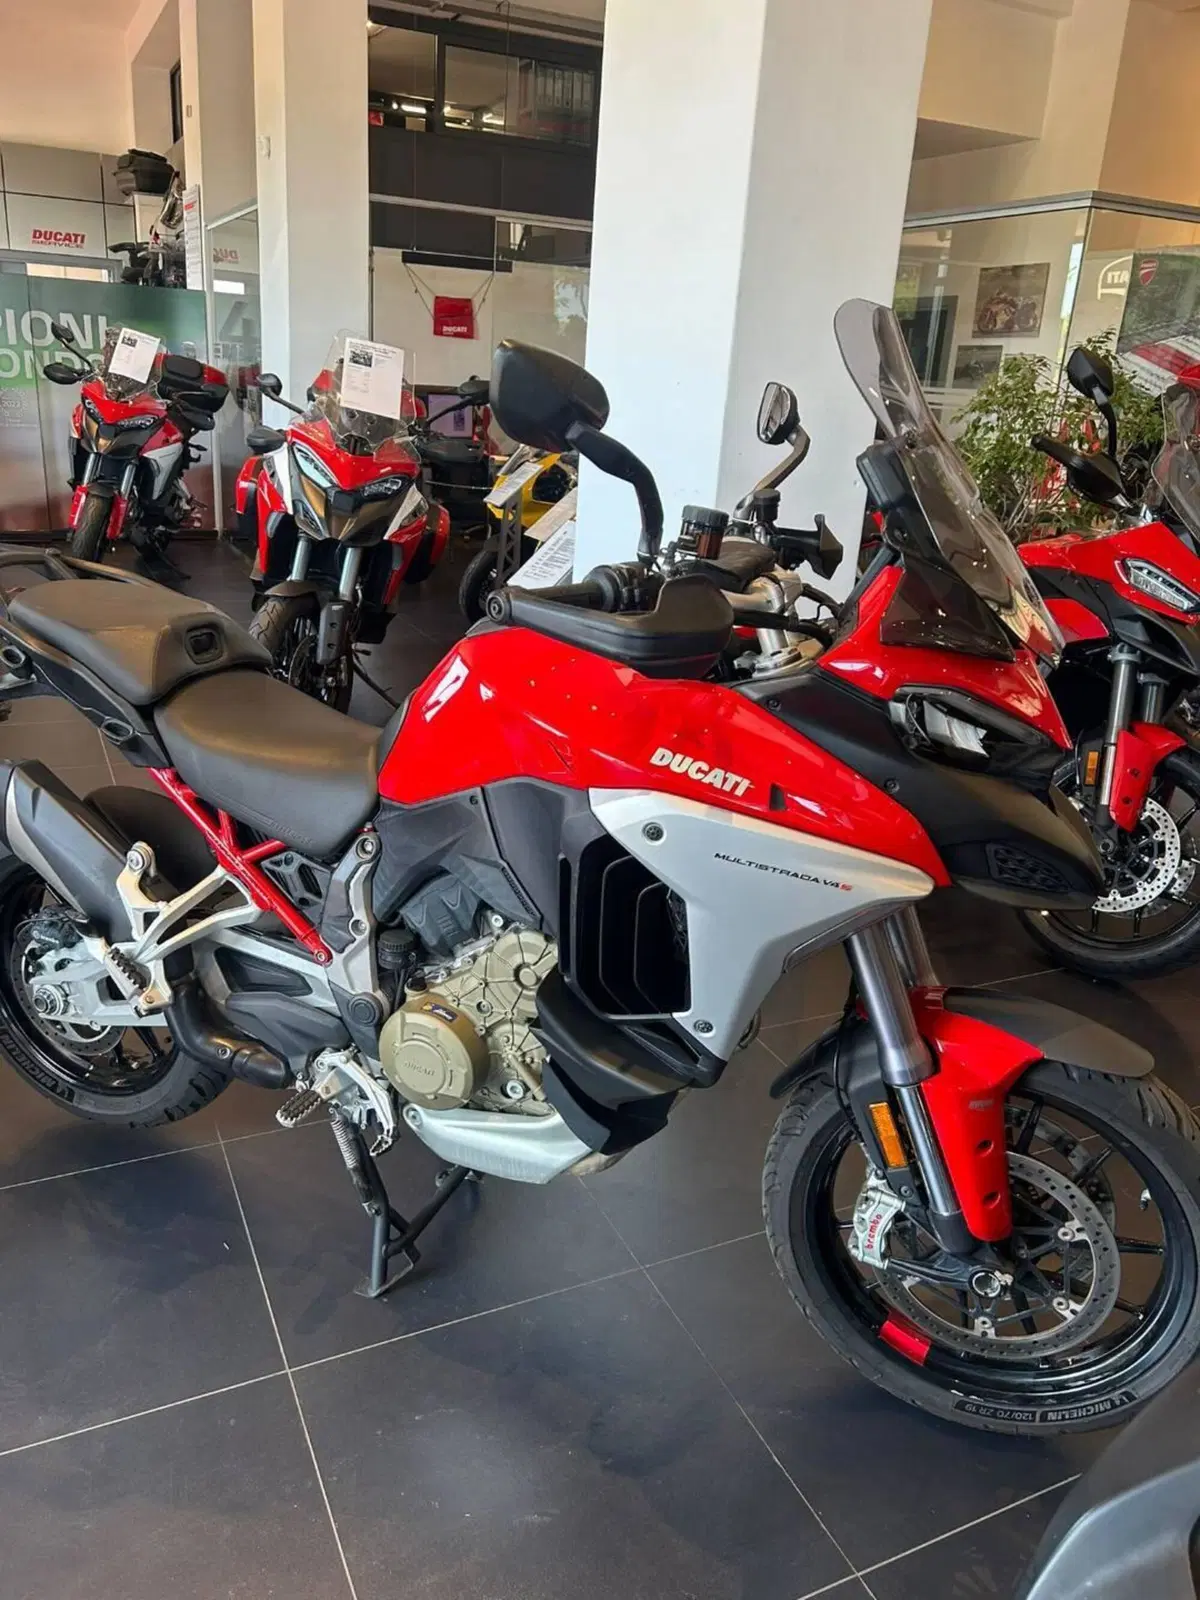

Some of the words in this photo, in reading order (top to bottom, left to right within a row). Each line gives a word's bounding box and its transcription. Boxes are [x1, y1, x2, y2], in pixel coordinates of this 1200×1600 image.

[32, 229, 86, 244] DUCATI
[0, 309, 107, 350] IONI
[443, 325, 467, 333] DUCATI
[650, 747, 751, 797] DUCATI
[714, 853, 820, 883] MULTISTRADA
[865, 1214, 882, 1249] brembo
[979, 1407, 993, 1416] ZR
[996, 1410, 1033, 1421] 120/70
[1048, 1399, 1111, 1421] MICHELIN
